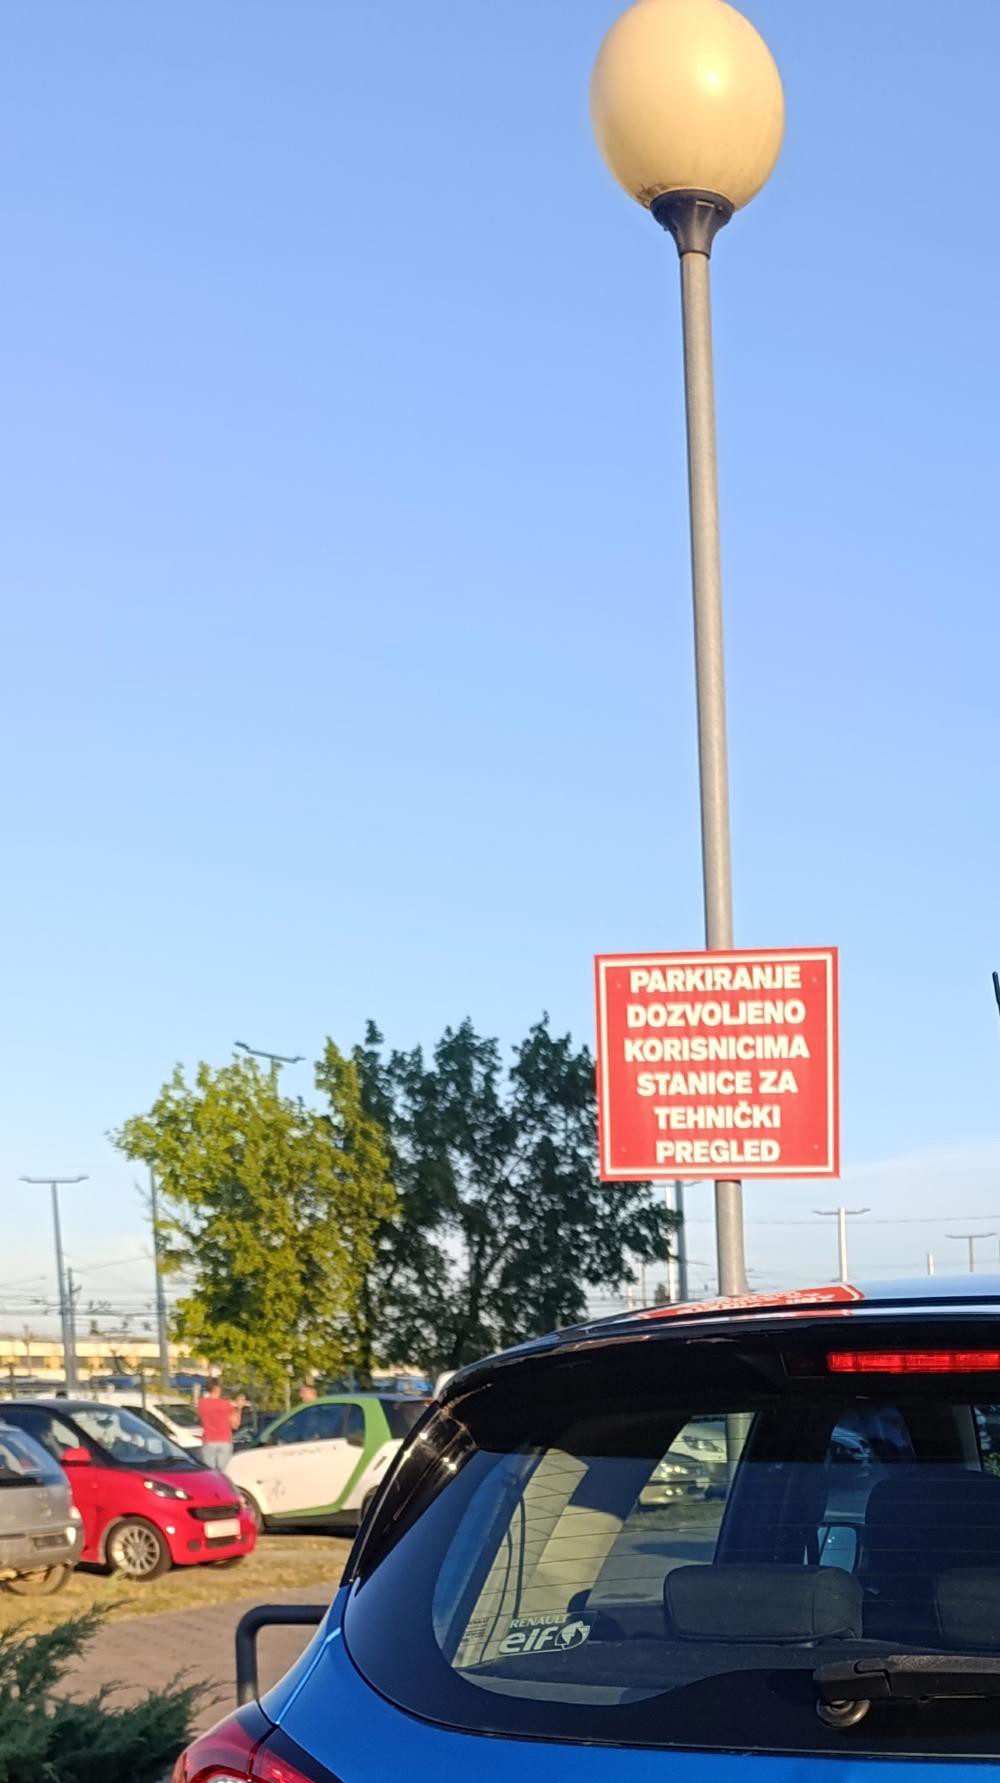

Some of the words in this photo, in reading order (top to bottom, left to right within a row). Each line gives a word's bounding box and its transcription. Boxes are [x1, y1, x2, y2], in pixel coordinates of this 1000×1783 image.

[630, 965, 802, 993] PARKIRANJE
[626, 1000, 806, 1028] DOZVOLJENO
[624, 1034, 810, 1062] KORISNICIMA
[637, 1070, 752, 1096] STANICE
[758, 1069, 798, 1094] ZA
[654, 1100, 781, 1130] TEHNIČKI
[656, 1138, 780, 1164] PREGLED
[509, 1614, 570, 1629] RENAULT
[499, 1626, 559, 1653] elf
